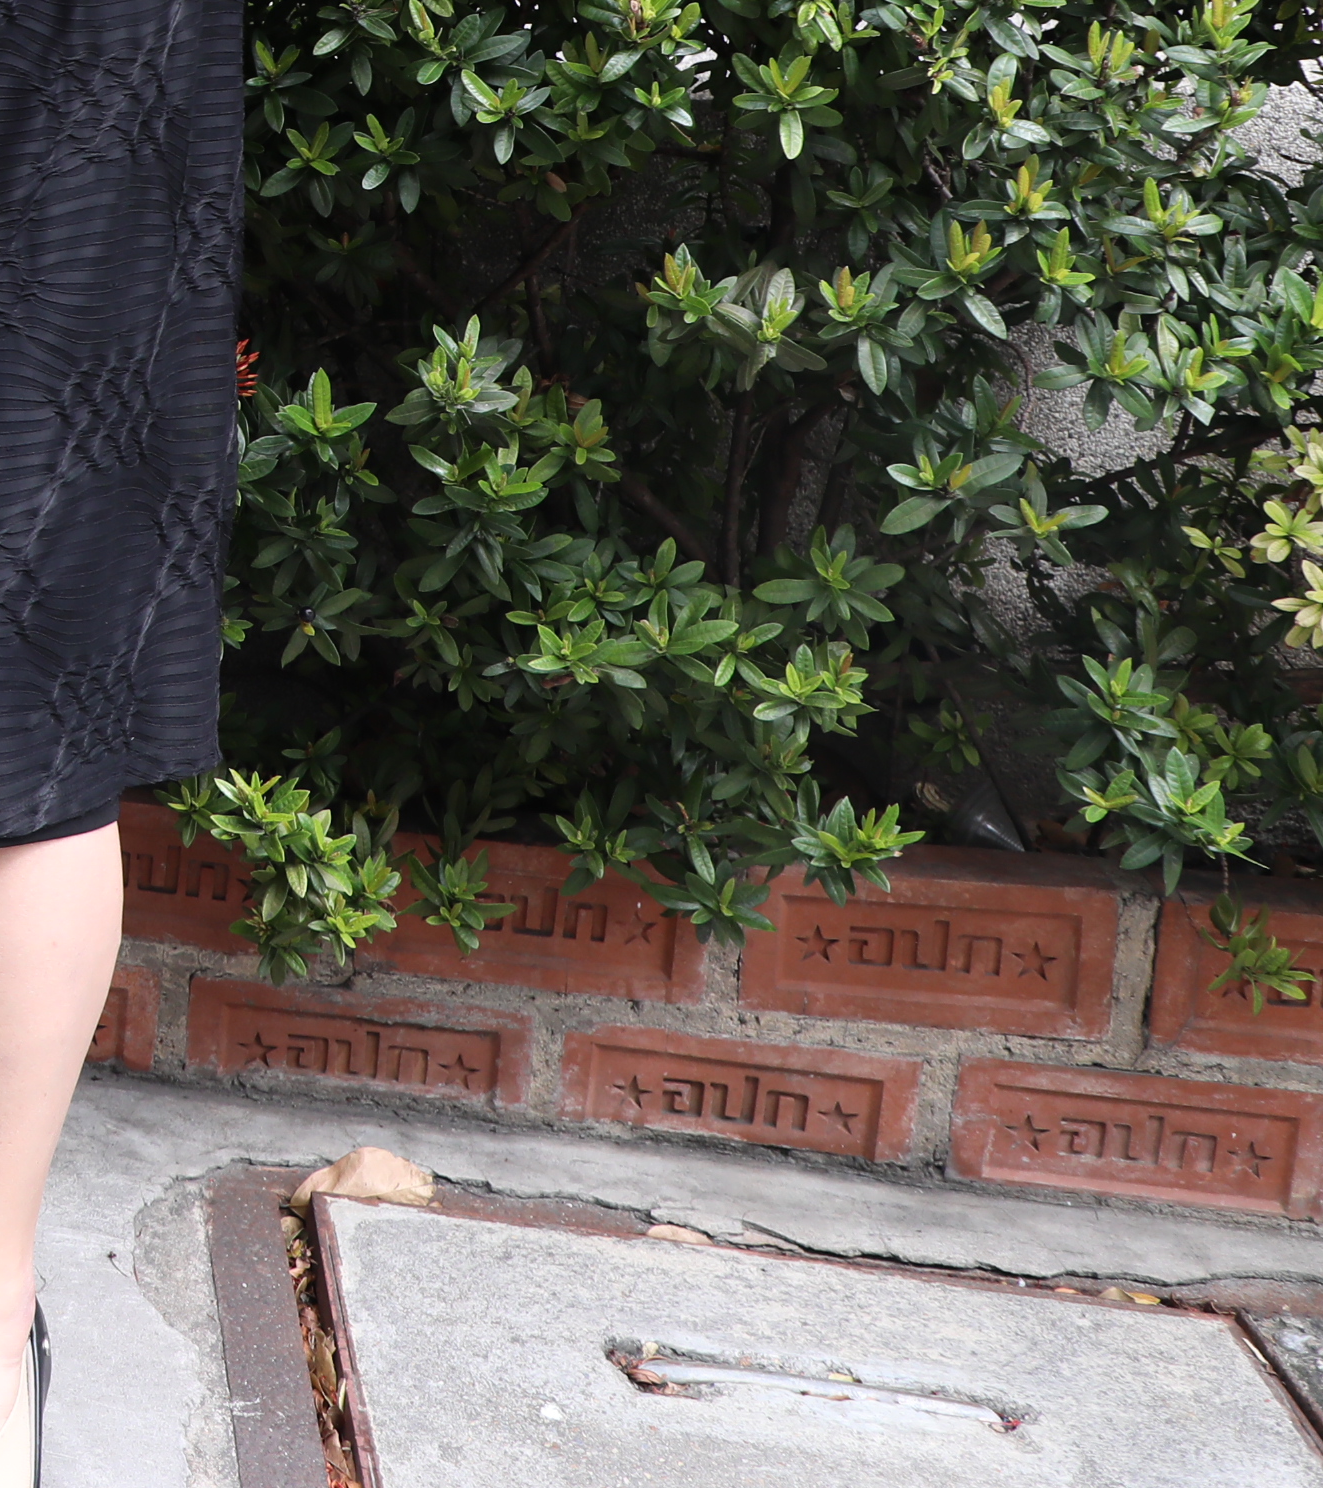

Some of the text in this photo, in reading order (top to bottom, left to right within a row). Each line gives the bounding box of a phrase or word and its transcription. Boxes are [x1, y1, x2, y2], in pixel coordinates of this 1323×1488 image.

[121, 845, 230, 901] ปก
[848, 920, 1003, 976] อปก
[286, 1031, 429, 1086] อปก
[662, 1076, 808, 1132] อปก
[1058, 1115, 1218, 1173] อปก
